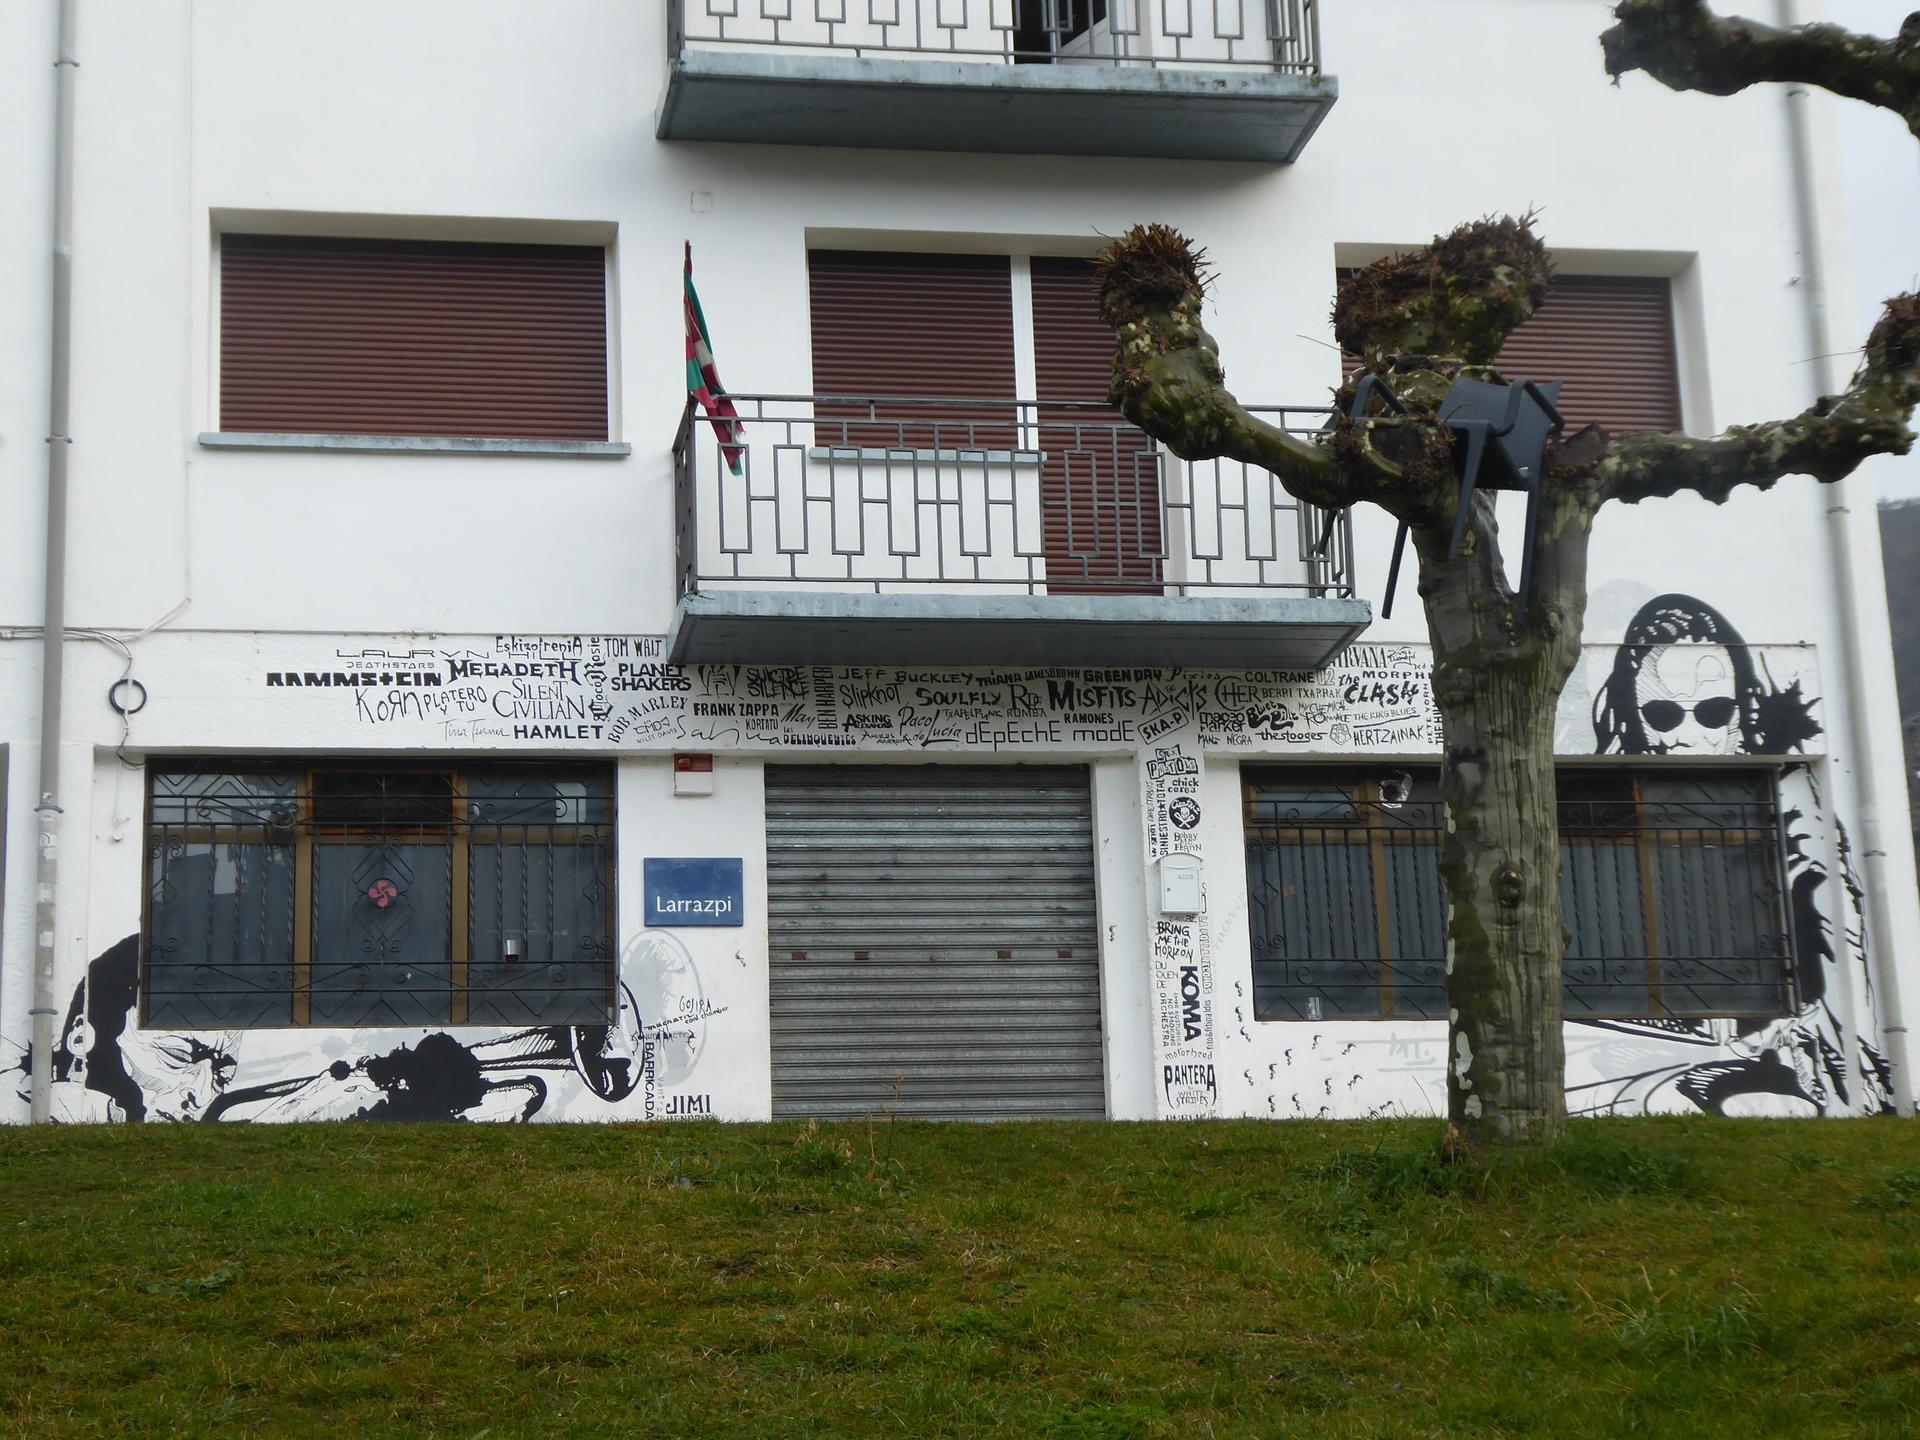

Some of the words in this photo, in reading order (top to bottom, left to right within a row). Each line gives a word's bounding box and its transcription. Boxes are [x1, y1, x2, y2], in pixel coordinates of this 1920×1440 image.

[336, 648, 490, 660] LAURYN
[508, 652, 582, 660] HILL
[604, 638, 628, 657] TOM
[346, 661, 435, 669] DEATHSTARS
[444, 659, 582, 686] MEGADETH
[618, 663, 687, 677] PLANET
[746, 666, 808, 682] SUICIDE
[839, 668, 887, 680] JEFF
[611, 677, 692, 691] SHAKERS
[1083, 670, 1132, 683] GREEN
[1134, 669, 1163, 682] DAY
[1245, 671, 1314, 683] COLTRANE
[512, 678, 568, 700] SILENT
[746, 680, 809, 700] SILENCE
[812, 667, 836, 706] HARPER
[1262, 688, 1292, 698] BERRI
[1297, 688, 1341, 699] TXARRAK
[1344, 681, 1419, 708] CLASH
[423, 686, 487, 713] PLATERO
[492, 690, 585, 719] CIVILIAN
[916, 687, 1001, 706] SOULFLY
[1423, 683, 1431, 712] YORN
[440, 705, 448, 715] Y
[456, 701, 475, 712] TU
[693, 703, 736, 716] FRANK
[739, 703, 779, 717] ZAPPA
[1354, 713, 1369, 721] THE
[1391, 707, 1417, 717] BLUES
[608, 716, 630, 744] BOB
[628, 696, 688, 721] MARLEY
[745, 719, 778, 730] KORTATU
[815, 709, 838, 729] BEN
[898, 702, 932, 736] Paco
[1064, 713, 1114, 724] RAMONES
[1142, 712, 1182, 740] SKA-P
[437, 719, 467, 742] Tina
[514, 725, 603, 739] HAMLET
[1226, 733, 1253, 746] NEGRA
[1353, 725, 1424, 746] HERTZAINAK
[1156, 779, 1166, 803] TOTAL
[1172, 777, 1199, 787] chick
[1158, 811, 1169, 856] SINIESTRO
[657, 896, 732, 917] Larrazpi
[1156, 921, 1191, 939] BRING
[1158, 934, 1171, 947] ME
[1155, 943, 1194, 964] HORIZON
[1157, 980, 1167, 989] DE
[679, 995, 711, 1014] GOJIRA
[1167, 998, 1173, 1009] NO
[1180, 965, 1202, 1042] KOMA
[1160, 992, 1170, 1047] ORCHESTRA
[1168, 1011, 1176, 1047] SMOKING
[645, 1042, 655, 1120] BARRICADA
[1164, 1064, 1217, 1110] PANTERA
[666, 1094, 710, 1114] JIMI
